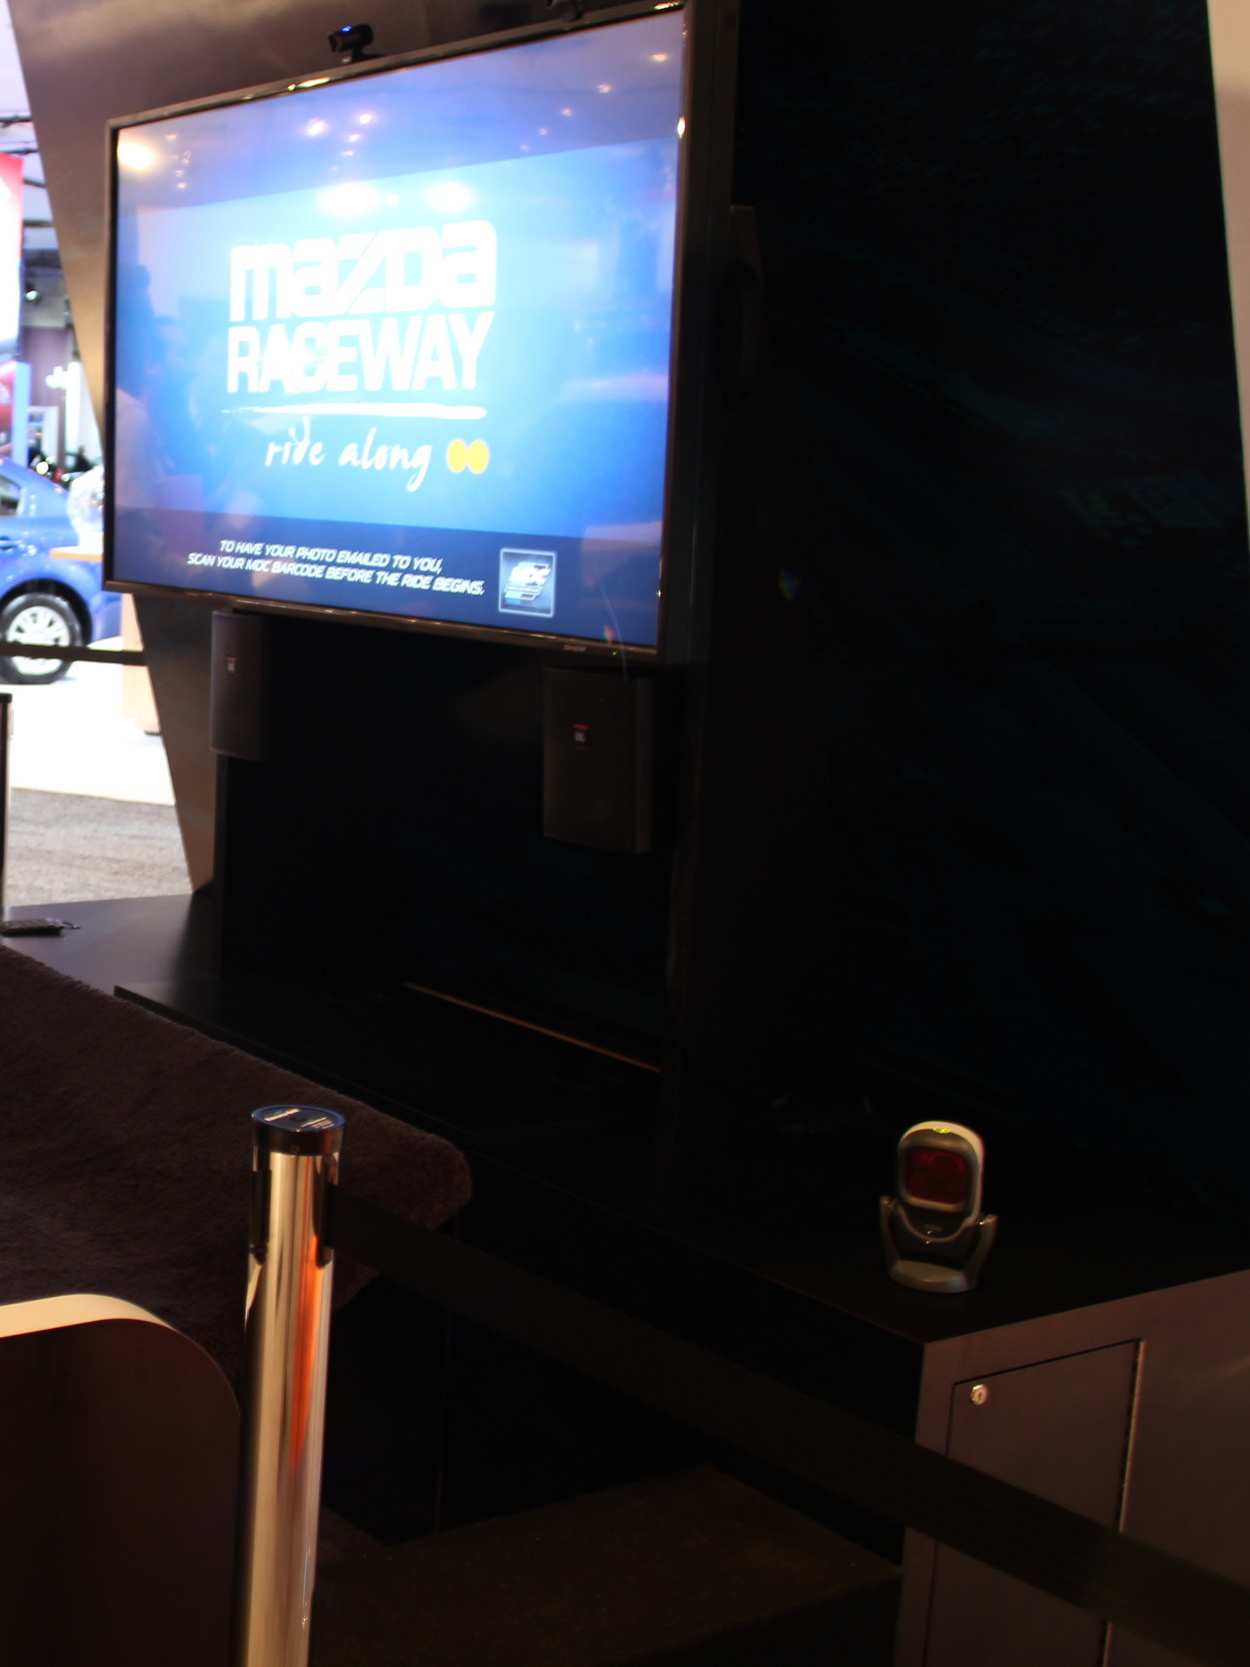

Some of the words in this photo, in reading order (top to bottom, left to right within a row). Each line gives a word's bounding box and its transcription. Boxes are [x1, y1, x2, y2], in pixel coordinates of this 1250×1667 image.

[226, 310, 496, 394] RACEWAY
[264, 414, 327, 468] ride
[338, 425, 433, 493] along
[187, 552, 216, 567] SCAN
[216, 554, 246, 570] YOUR
[245, 557, 273, 573] MDC
[271, 560, 326, 579] BARCODE
[325, 564, 374, 585] BEFORE
[375, 570, 401, 587] THE
[401, 573, 432, 591] RIDE
[220, 539, 235, 552] TO
[235, 541, 265, 557] HAVE
[265, 543, 297, 560] YOUR
[296, 545, 337, 563] PHOTO
[336, 548, 391, 568] EMAILED
[392, 553, 412, 569] TO
[412, 556, 443, 575] YOU,
